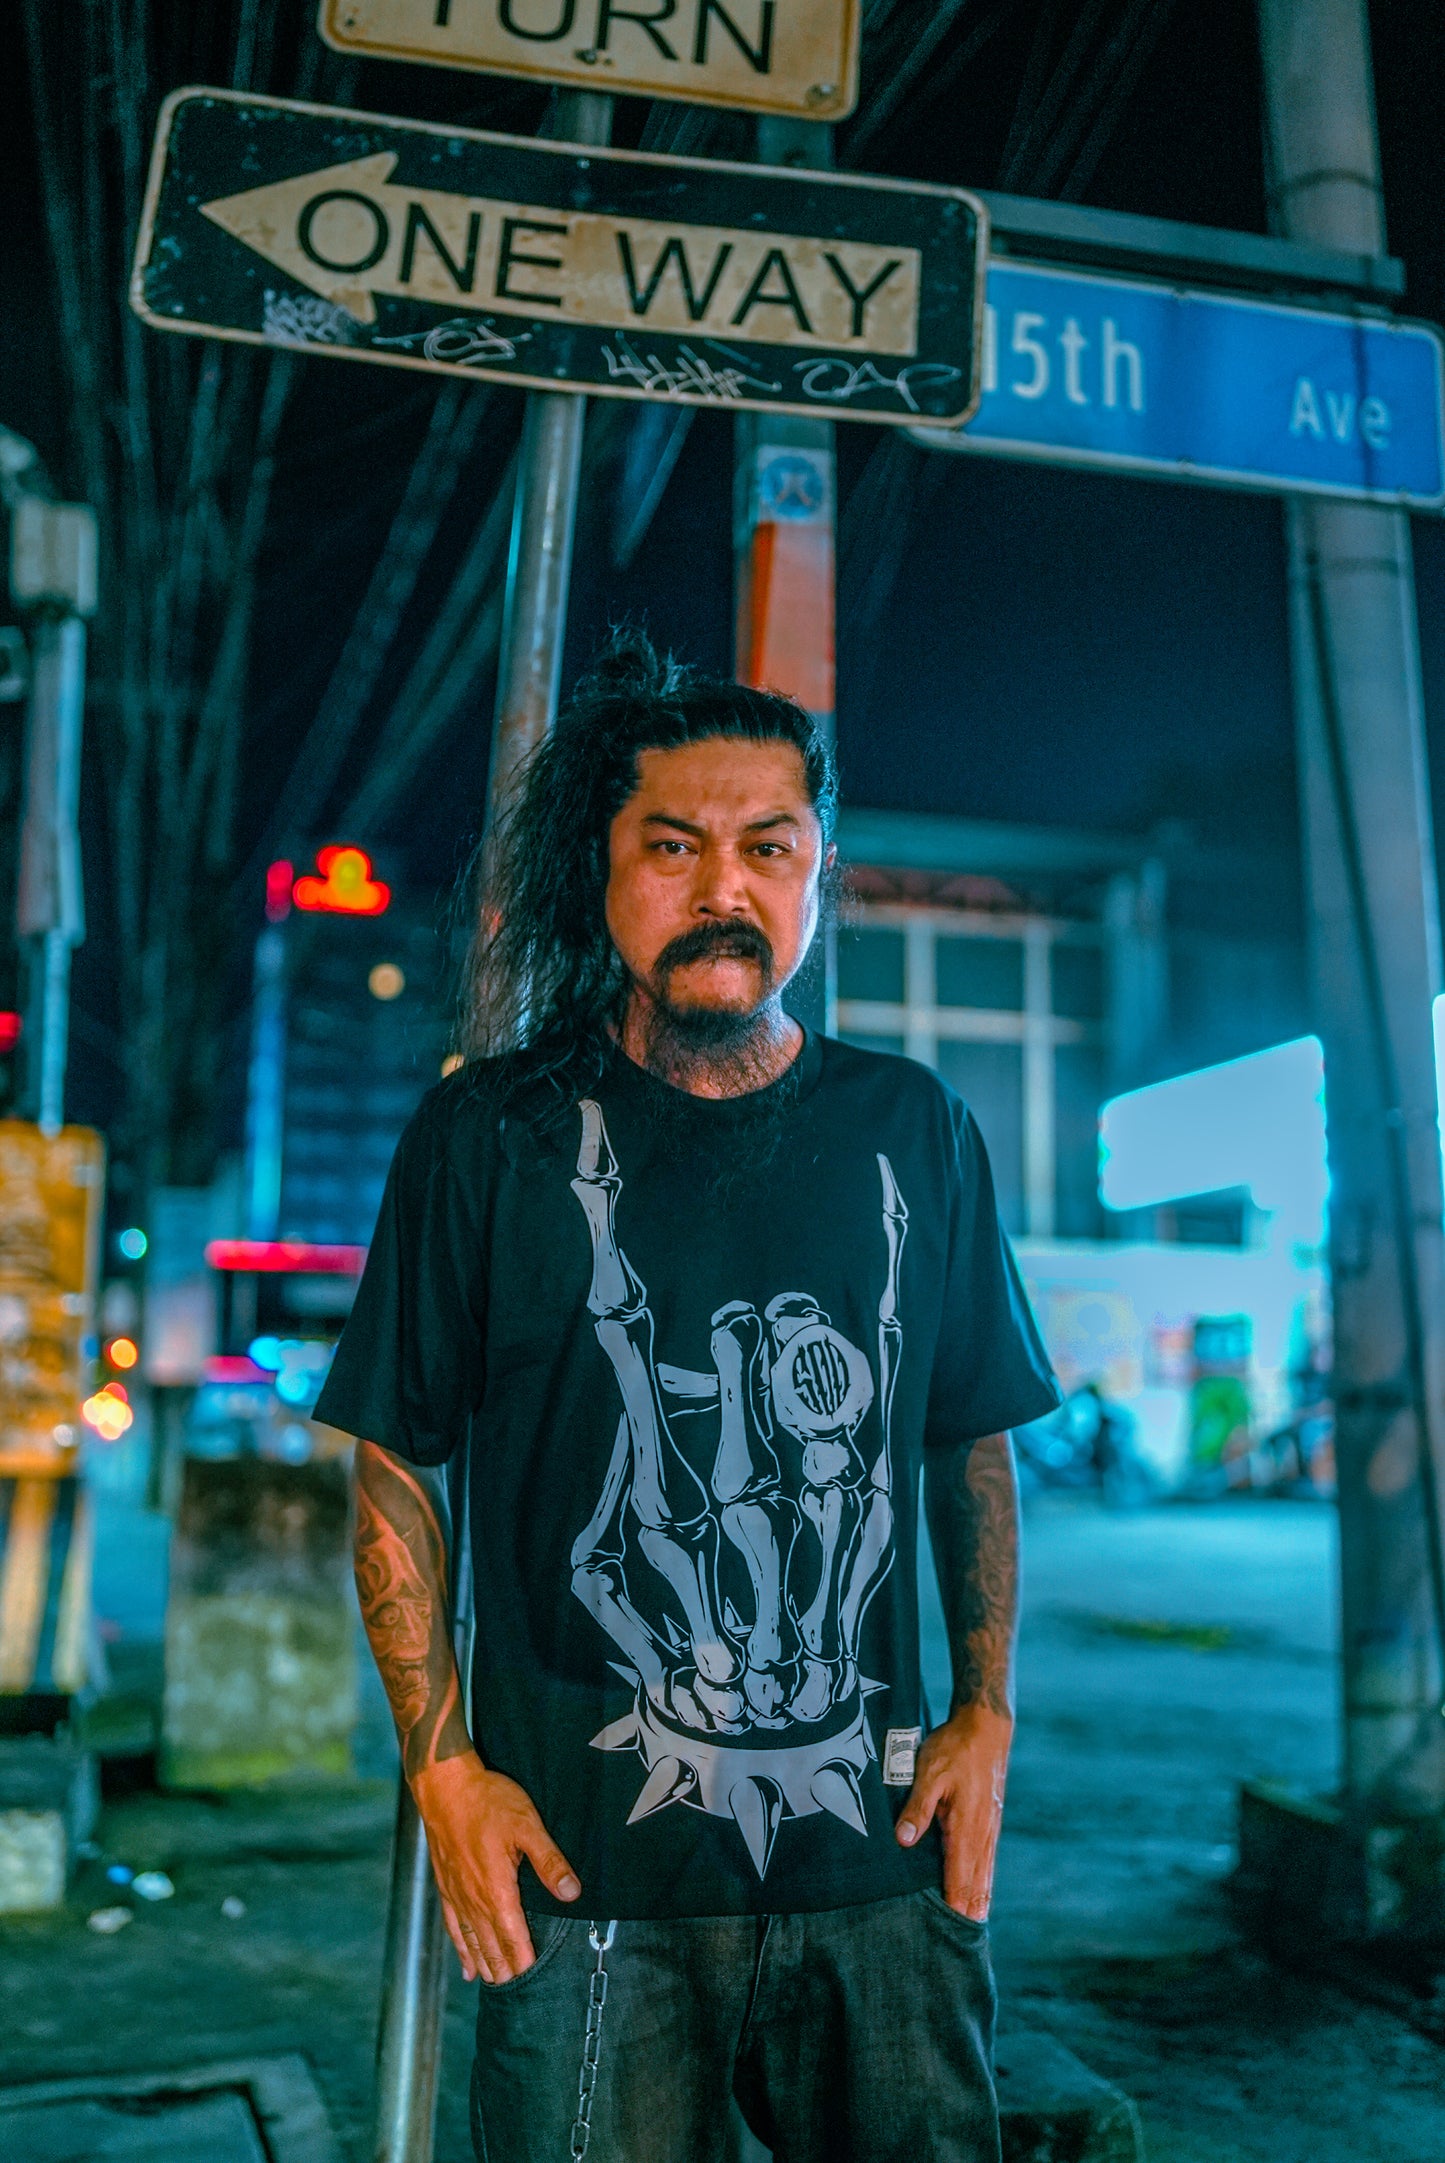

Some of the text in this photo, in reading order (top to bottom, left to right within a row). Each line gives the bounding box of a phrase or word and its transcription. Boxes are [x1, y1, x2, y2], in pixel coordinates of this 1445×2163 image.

[297, 188, 902, 337] ONE WAY
[1290, 375, 1392, 450] Ave
